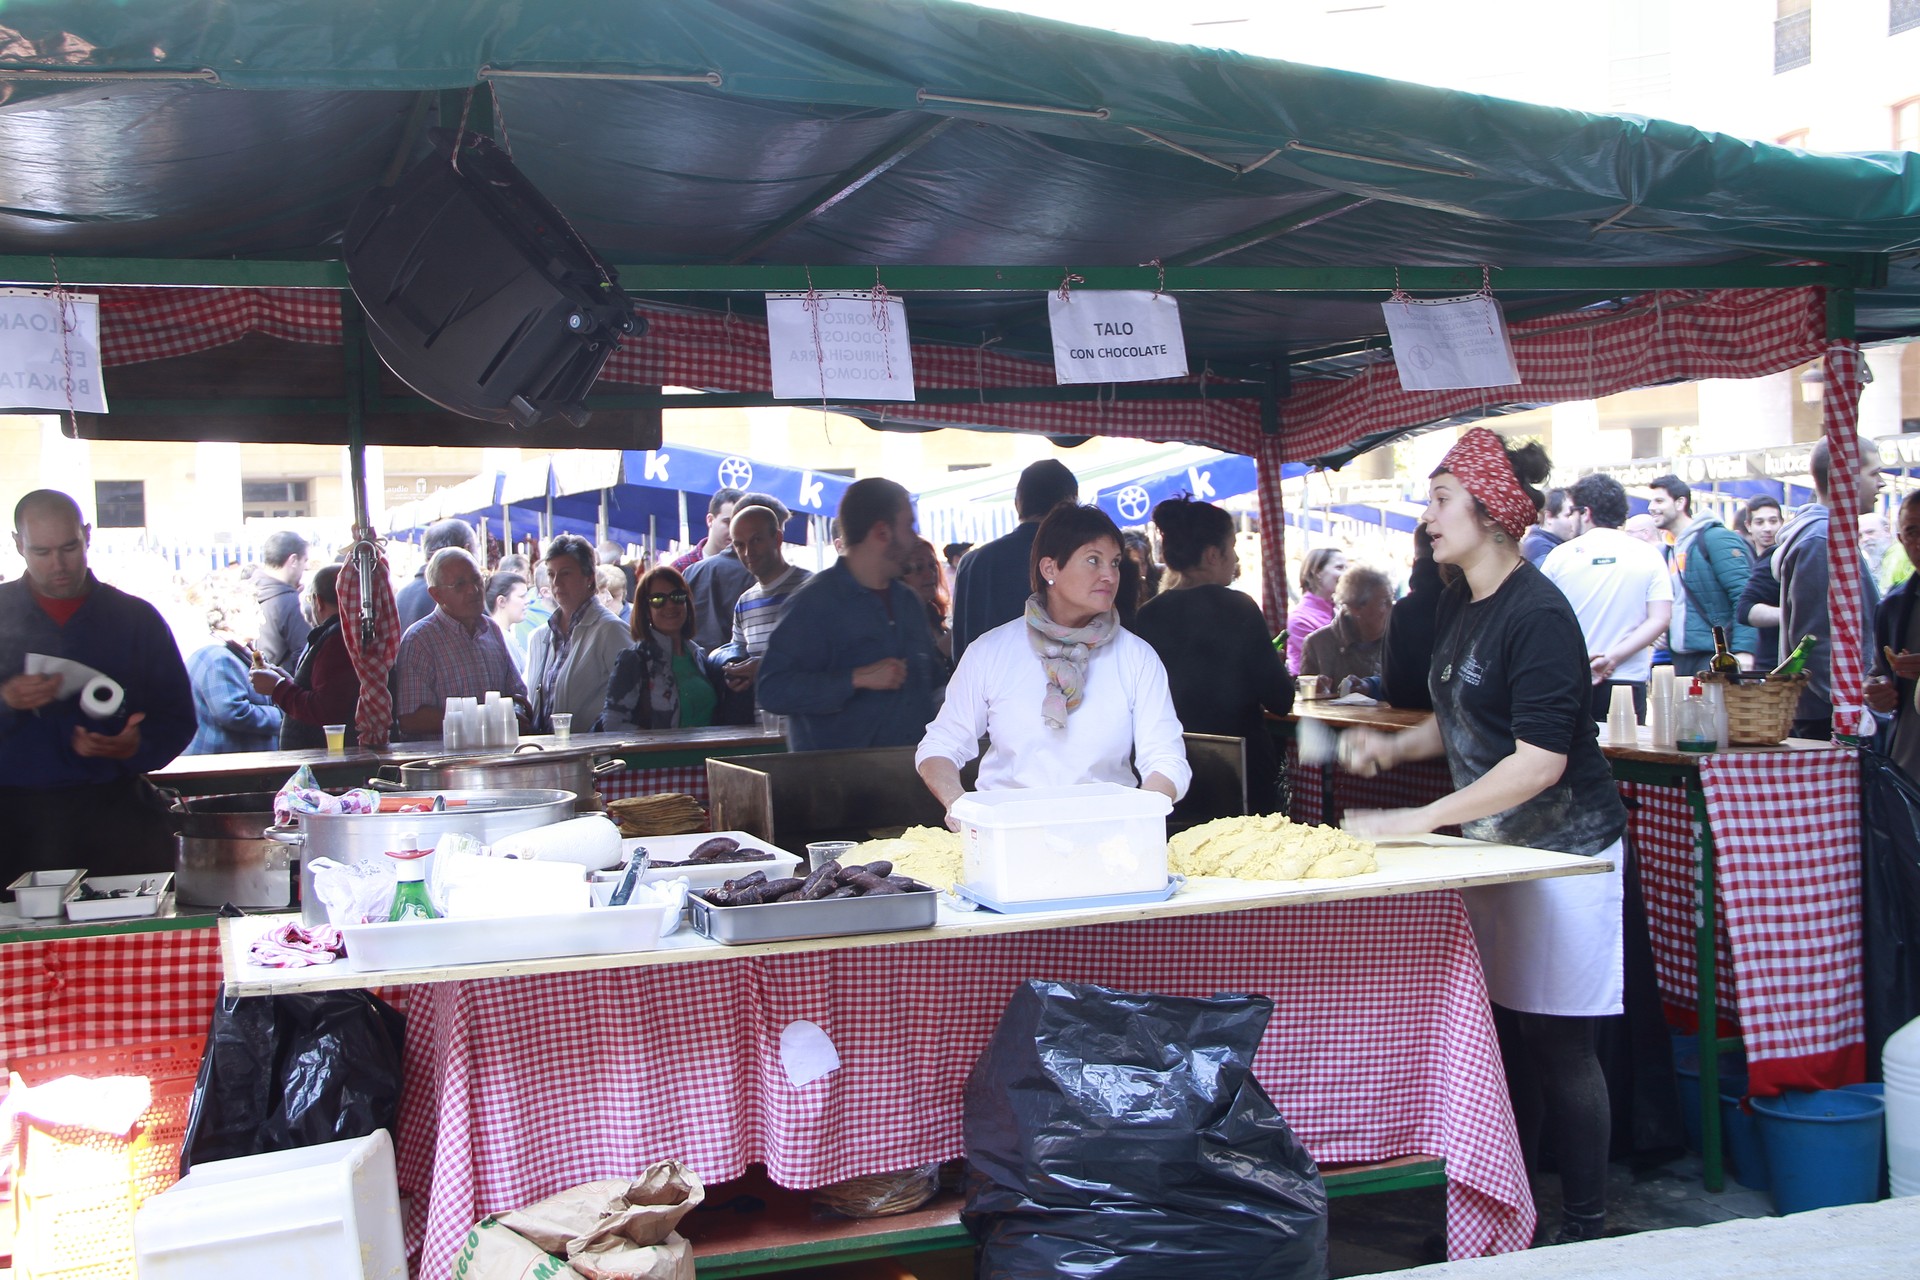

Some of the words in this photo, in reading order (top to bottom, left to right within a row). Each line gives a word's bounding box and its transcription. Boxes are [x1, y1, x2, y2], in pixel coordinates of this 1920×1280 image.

[1094, 322, 1134, 336] TALO
[1070, 349, 1095, 359] CON
[1098, 344, 1167, 358] CHOCOLATE
[644, 450, 670, 482] k
[799, 470, 824, 509] k
[1188, 466, 1216, 500] k
